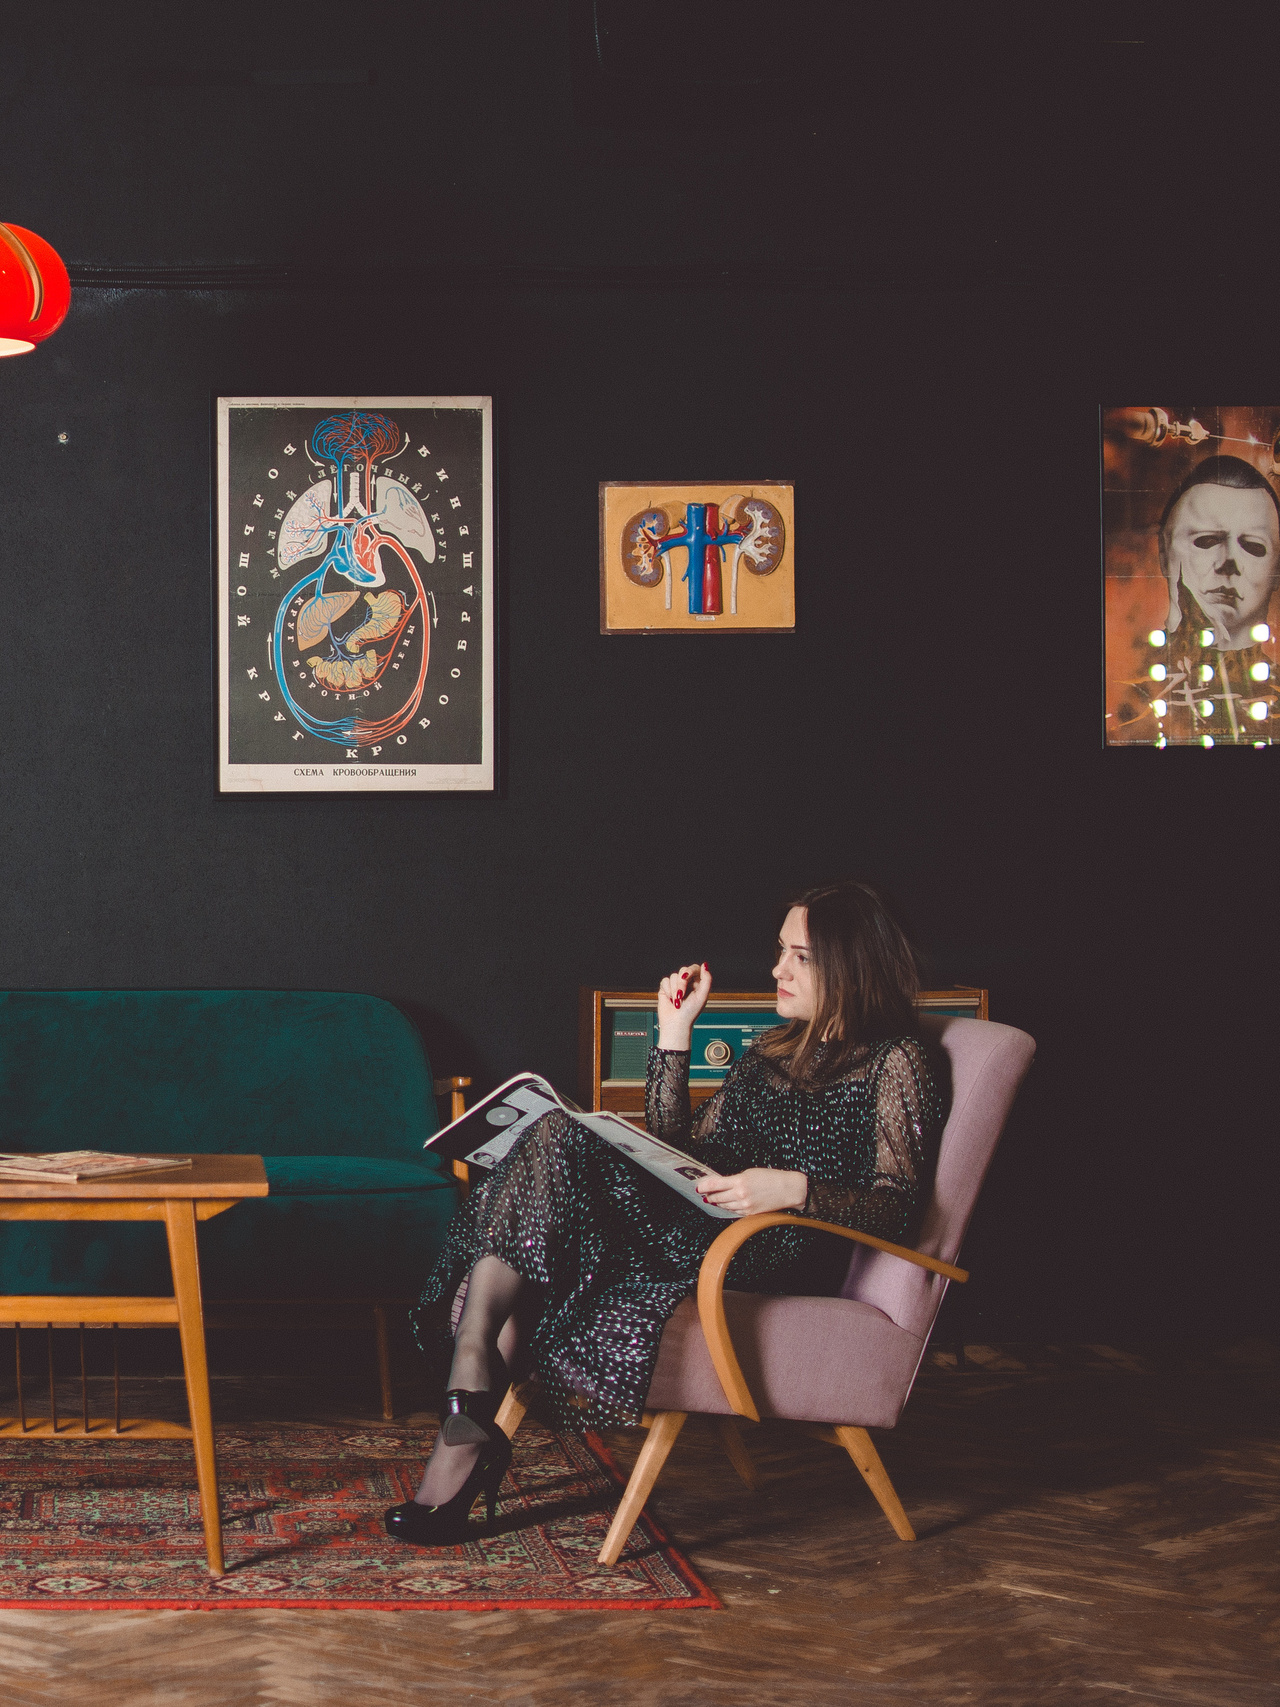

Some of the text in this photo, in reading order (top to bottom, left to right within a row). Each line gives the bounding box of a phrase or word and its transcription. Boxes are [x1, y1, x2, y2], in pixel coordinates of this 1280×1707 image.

[237, 443, 297, 627] БОЛЬШОЙ
[266, 489, 298, 579] МАЛЫЙ
[431, 512, 447, 563] КРУГ
[287, 596, 416, 701] КРУГ ВОРОТНОЙ ВЕНЫ
[346, 444, 474, 758] КРОВООБРАЩЕНИЯ
[247, 667, 304, 741] КРУГ
[293, 767, 417, 777] СХЕМА КРОВООБРАЩЕНИЯ
